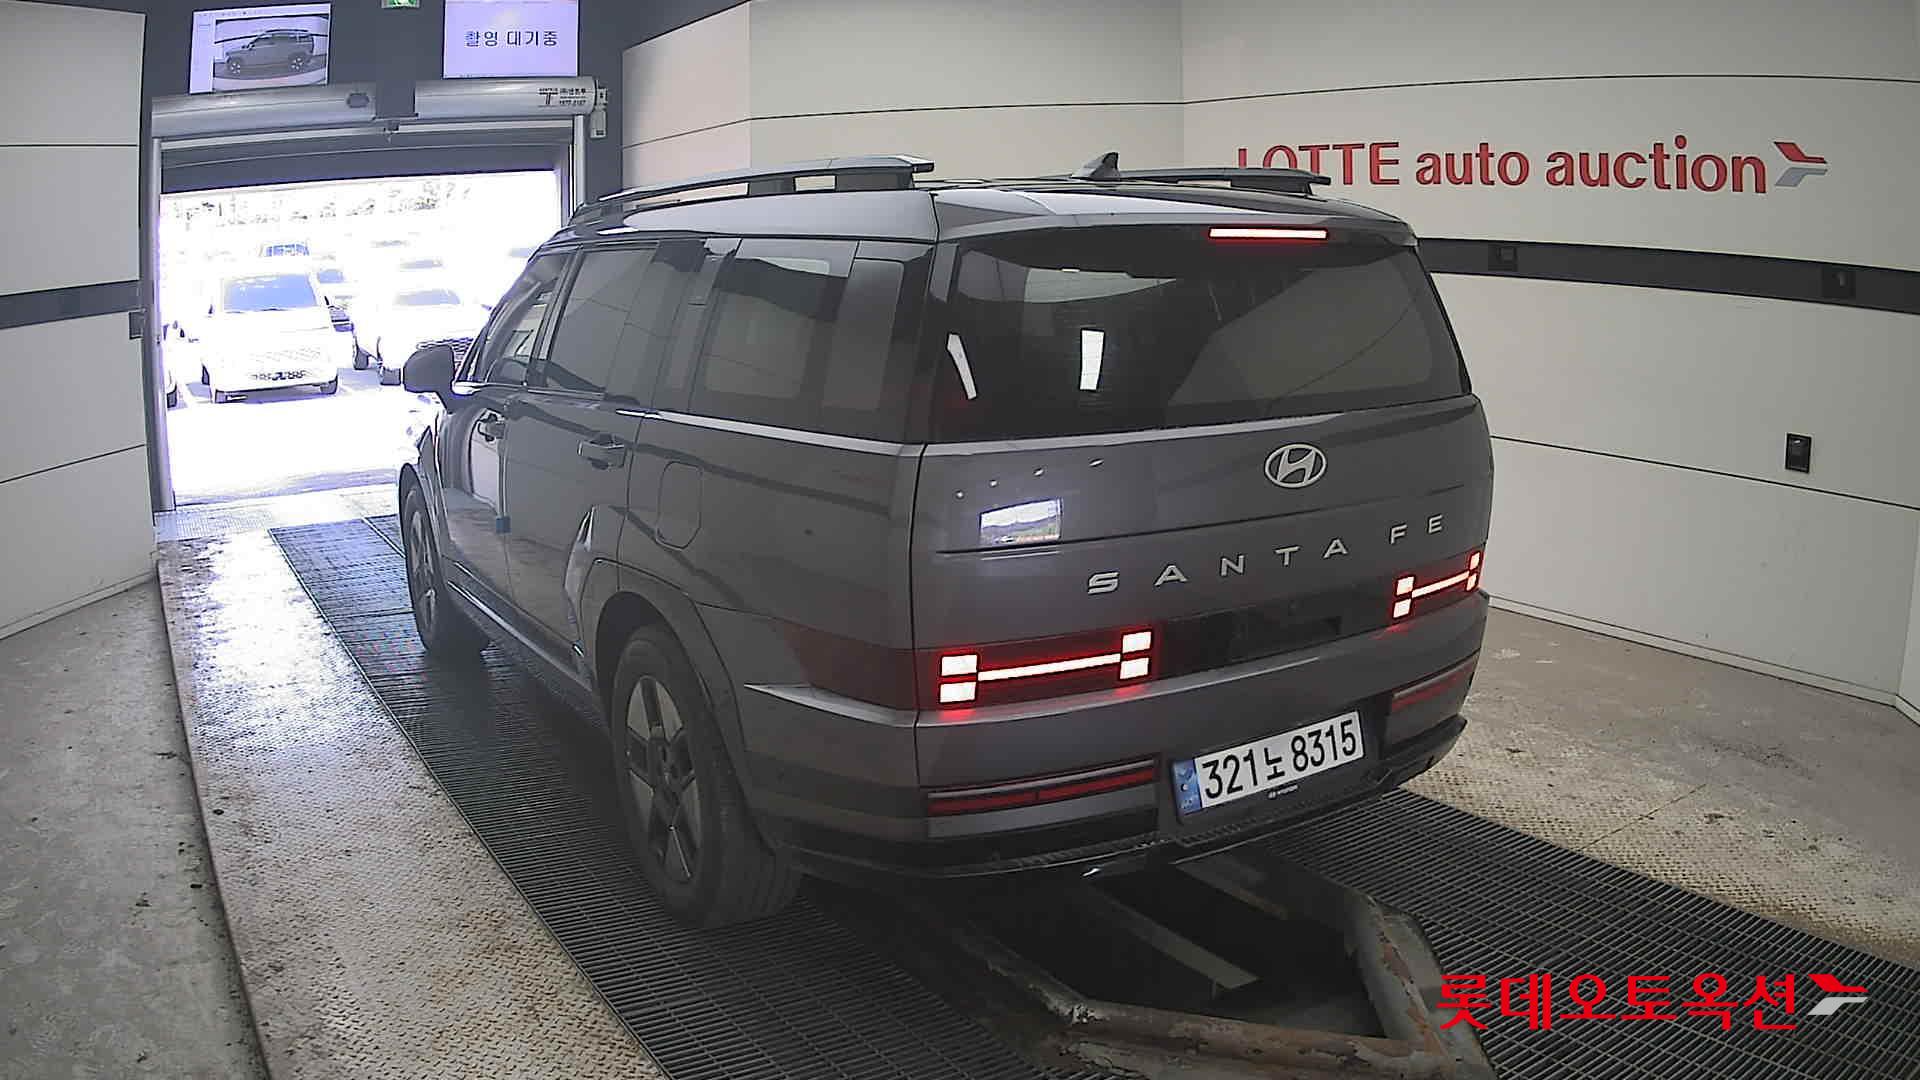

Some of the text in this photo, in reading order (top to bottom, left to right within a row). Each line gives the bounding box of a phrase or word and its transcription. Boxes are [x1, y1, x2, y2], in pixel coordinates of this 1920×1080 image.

[506, 30, 559, 47] 대기중
[1415, 142, 1529, 186] auto
[1546, 135, 1767, 193] auction
[1087, 514, 1444, 595] SANTA FE
